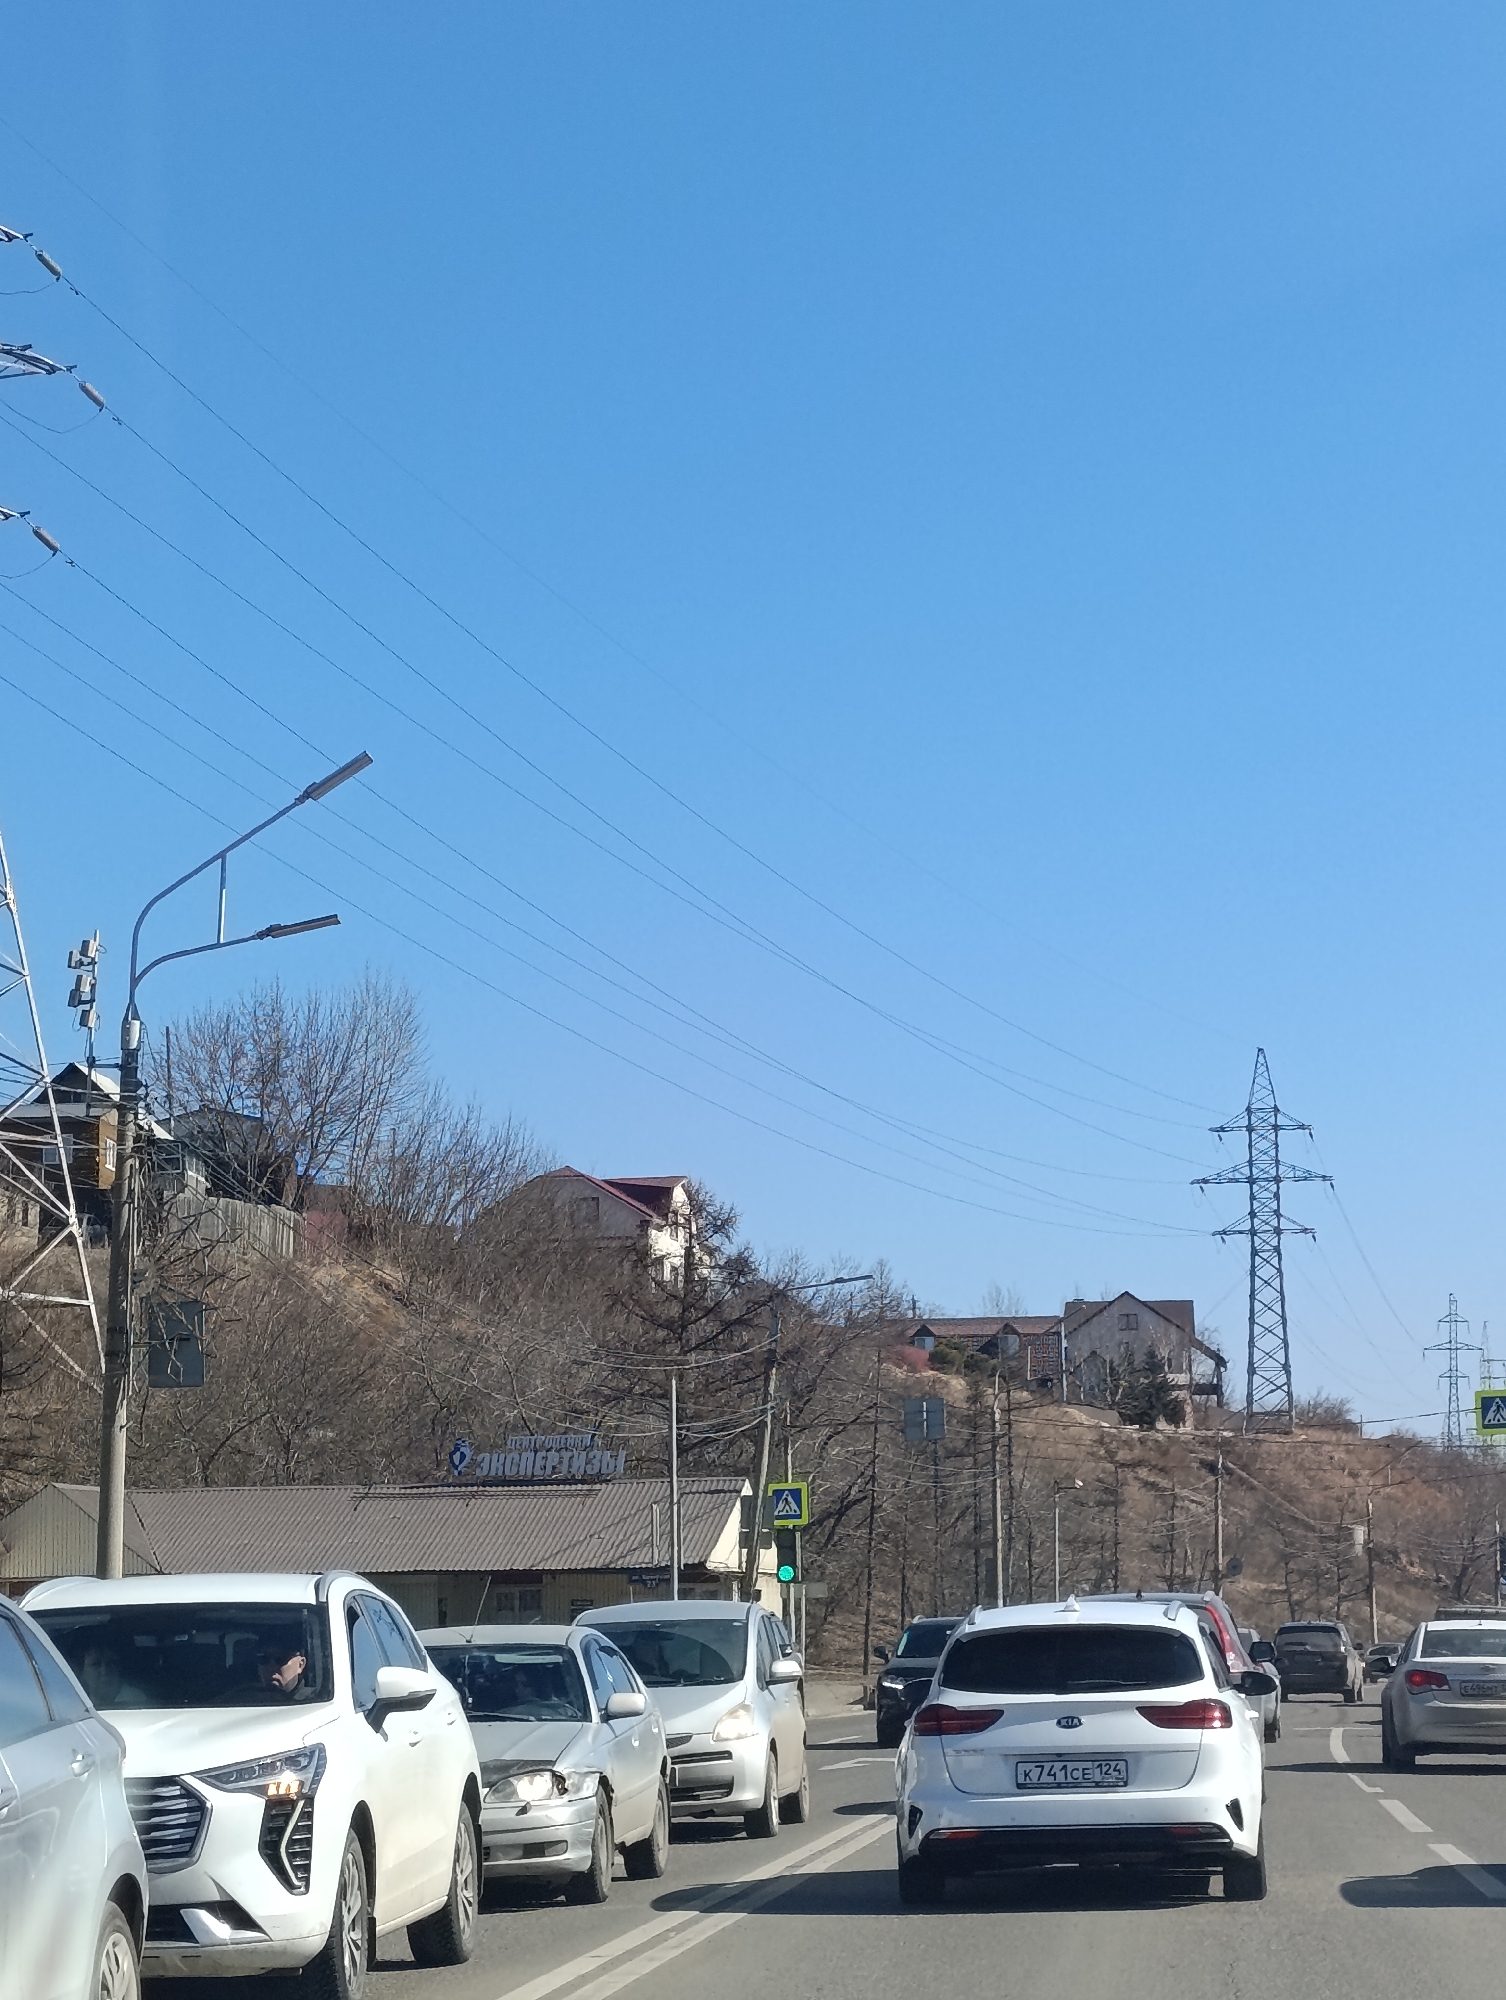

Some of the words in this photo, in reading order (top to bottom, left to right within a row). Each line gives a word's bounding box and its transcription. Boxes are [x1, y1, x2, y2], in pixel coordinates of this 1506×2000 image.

[475, 1449, 626, 1476] ЭКСПЕРТИЗЫ
[1059, 1717, 1081, 1727] KIA
[1095, 1762, 1121, 1776] 124
